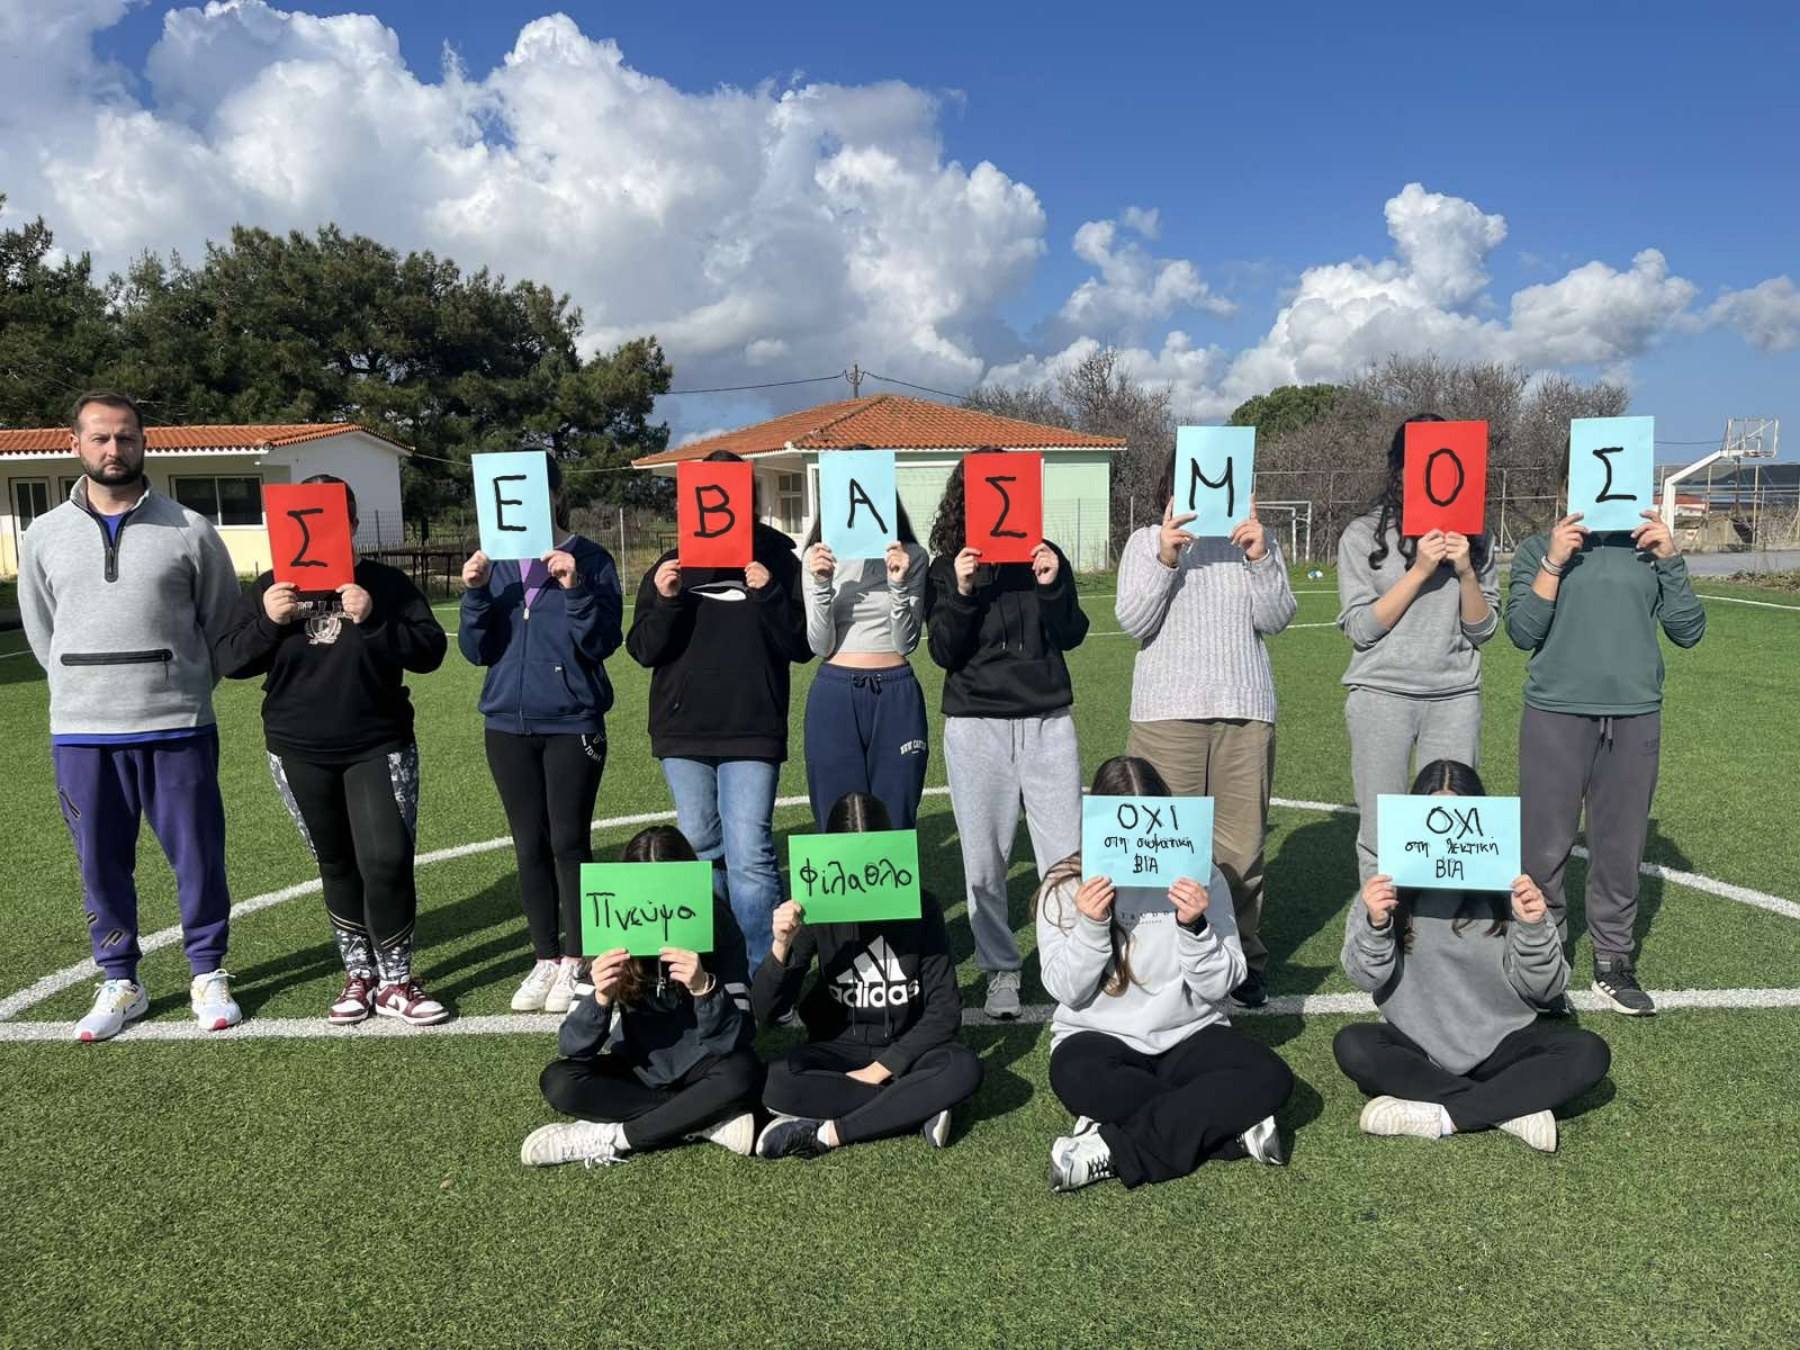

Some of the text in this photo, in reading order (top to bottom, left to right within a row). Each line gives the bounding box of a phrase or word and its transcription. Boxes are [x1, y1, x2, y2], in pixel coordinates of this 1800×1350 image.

[1188, 456, 1235, 518] Μ
[1425, 448, 1465, 507] Ο
[1592, 446, 1638, 504] Σ
[492, 474, 527, 532] Ε
[694, 484, 736, 539] Β
[846, 478, 888, 535] Α
[985, 475, 1028, 539] Σ
[287, 507, 328, 568] Σ
[1117, 803, 1179, 834] ΟΧΙ
[1426, 806, 1484, 839] ΟΧΙ
[1104, 836, 1128, 854] στη
[1132, 853, 1159, 874] ΒΙΑ
[1404, 841, 1429, 858] στη
[799, 857, 913, 897] Φίλαθλο
[1435, 859, 1465, 881] ΒΙΑ
[828, 979, 920, 1008] adidas
